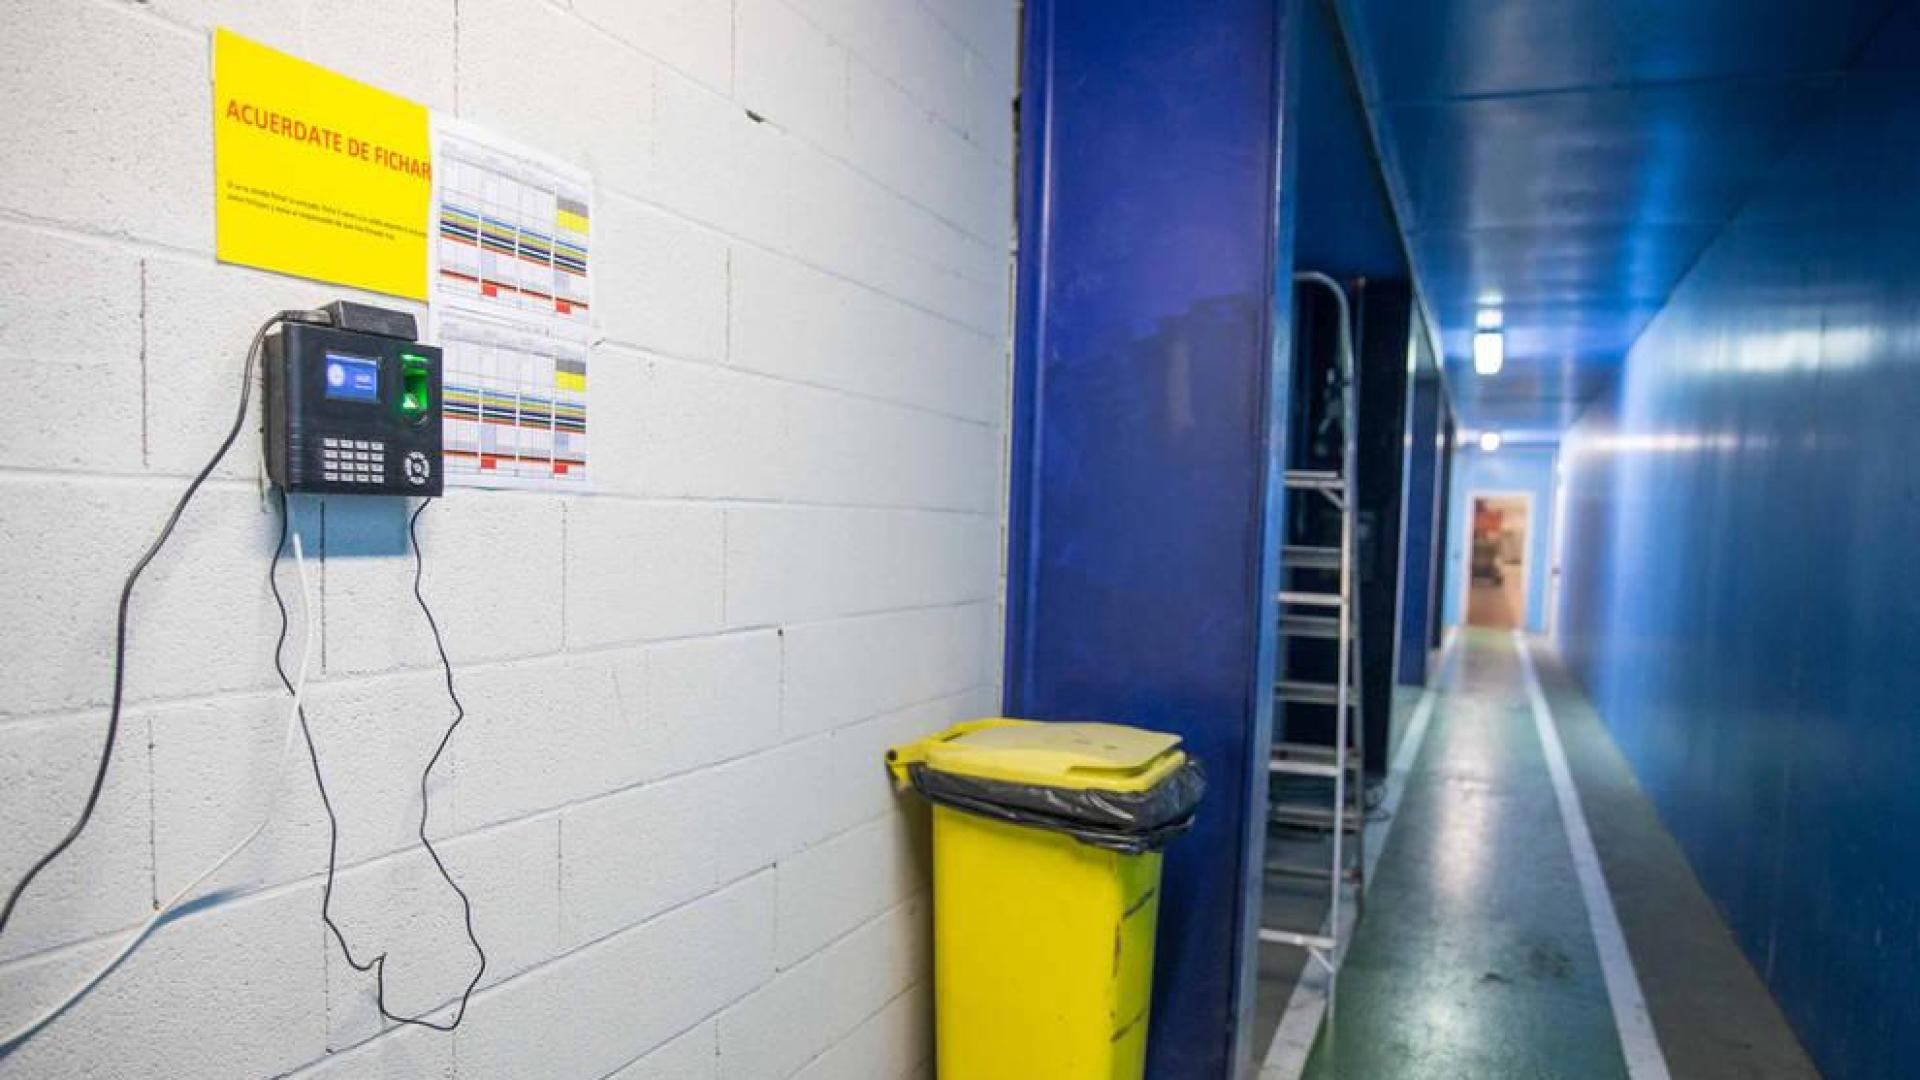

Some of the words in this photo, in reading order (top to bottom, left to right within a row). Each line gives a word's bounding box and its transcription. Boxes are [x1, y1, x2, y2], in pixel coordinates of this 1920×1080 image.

[227, 100, 342, 153] ACUERDATE
[347, 138, 370, 162] DE
[374, 146, 431, 183] FICHAR
